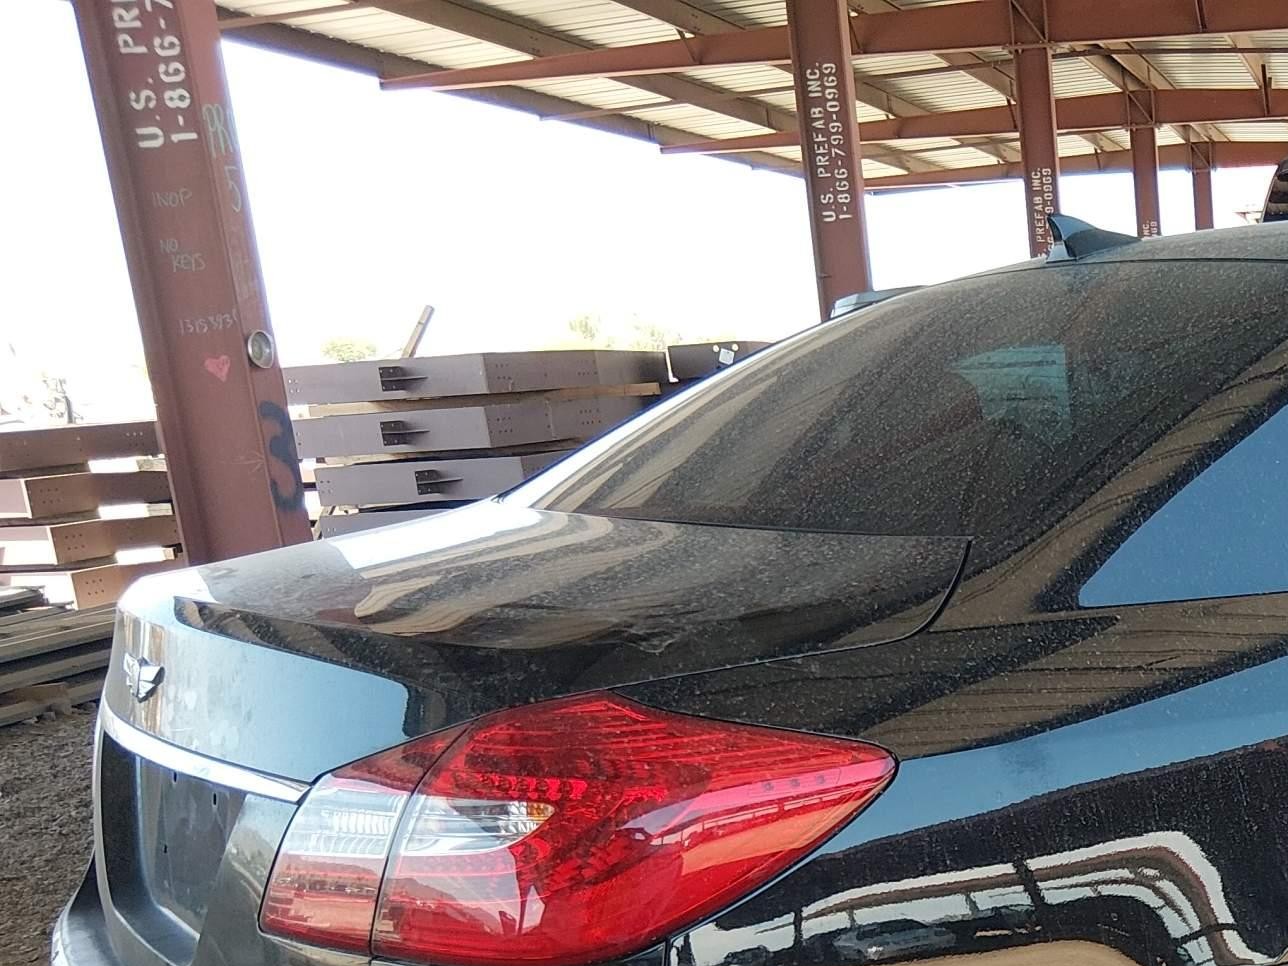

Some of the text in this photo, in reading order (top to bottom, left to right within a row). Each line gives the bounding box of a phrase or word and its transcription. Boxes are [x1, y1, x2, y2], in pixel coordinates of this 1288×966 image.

[112, 0, 165, 148] U.S. PR
[806, 62, 837, 222] U.S. PREFAB INC.
[822, 63, 852, 220] 1-866-799-0969
[152, 188, 192, 208] INOP
[1031, 167, 1042, 191] INC.
[1033, 196, 1046, 243] PREFAB
[160, 239, 178, 253] NO
